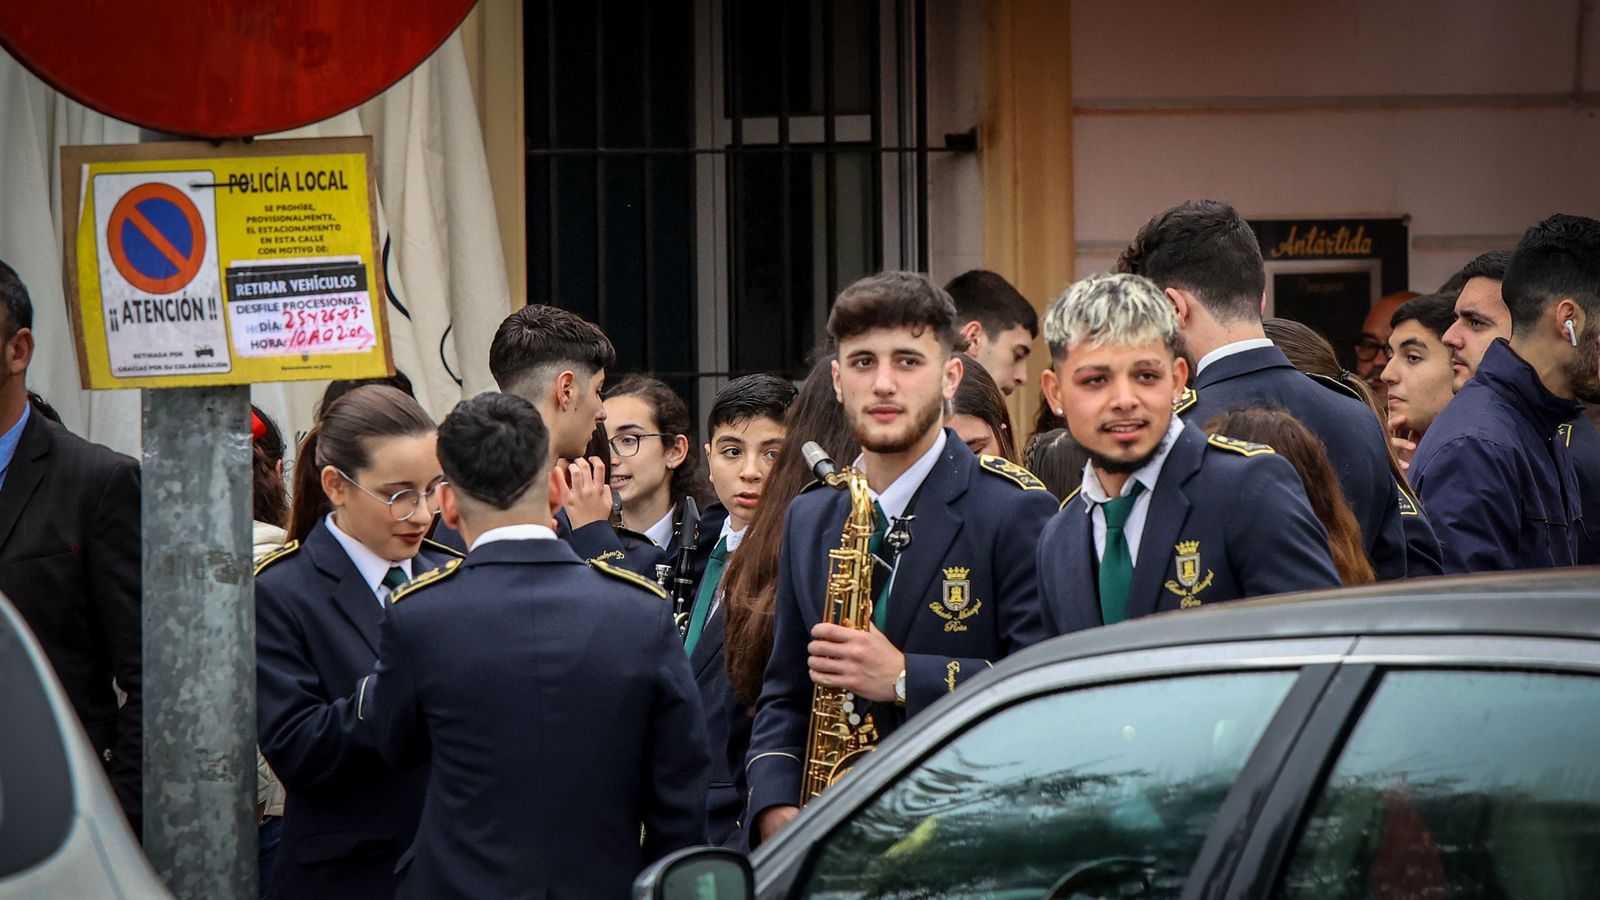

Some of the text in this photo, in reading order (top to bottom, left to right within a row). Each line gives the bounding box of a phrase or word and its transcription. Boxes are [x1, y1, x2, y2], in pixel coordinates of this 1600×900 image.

[229, 166, 349, 194] POLICÍA LOCAL
[258, 224, 341, 234] ESTACIONAMIENTO
[260, 236, 272, 244] EN
[298, 235, 324, 243] CALLE
[258, 247, 276, 255] CON
[280, 246, 313, 254] MOTIVO
[235, 274, 357, 297] RETIRAR VEHÍCULOS
[123, 291, 205, 324] ATENCIÓN
[236, 297, 362, 314] DESFILE PROCESIONAL
[251, 339, 287, 350] HORA:
